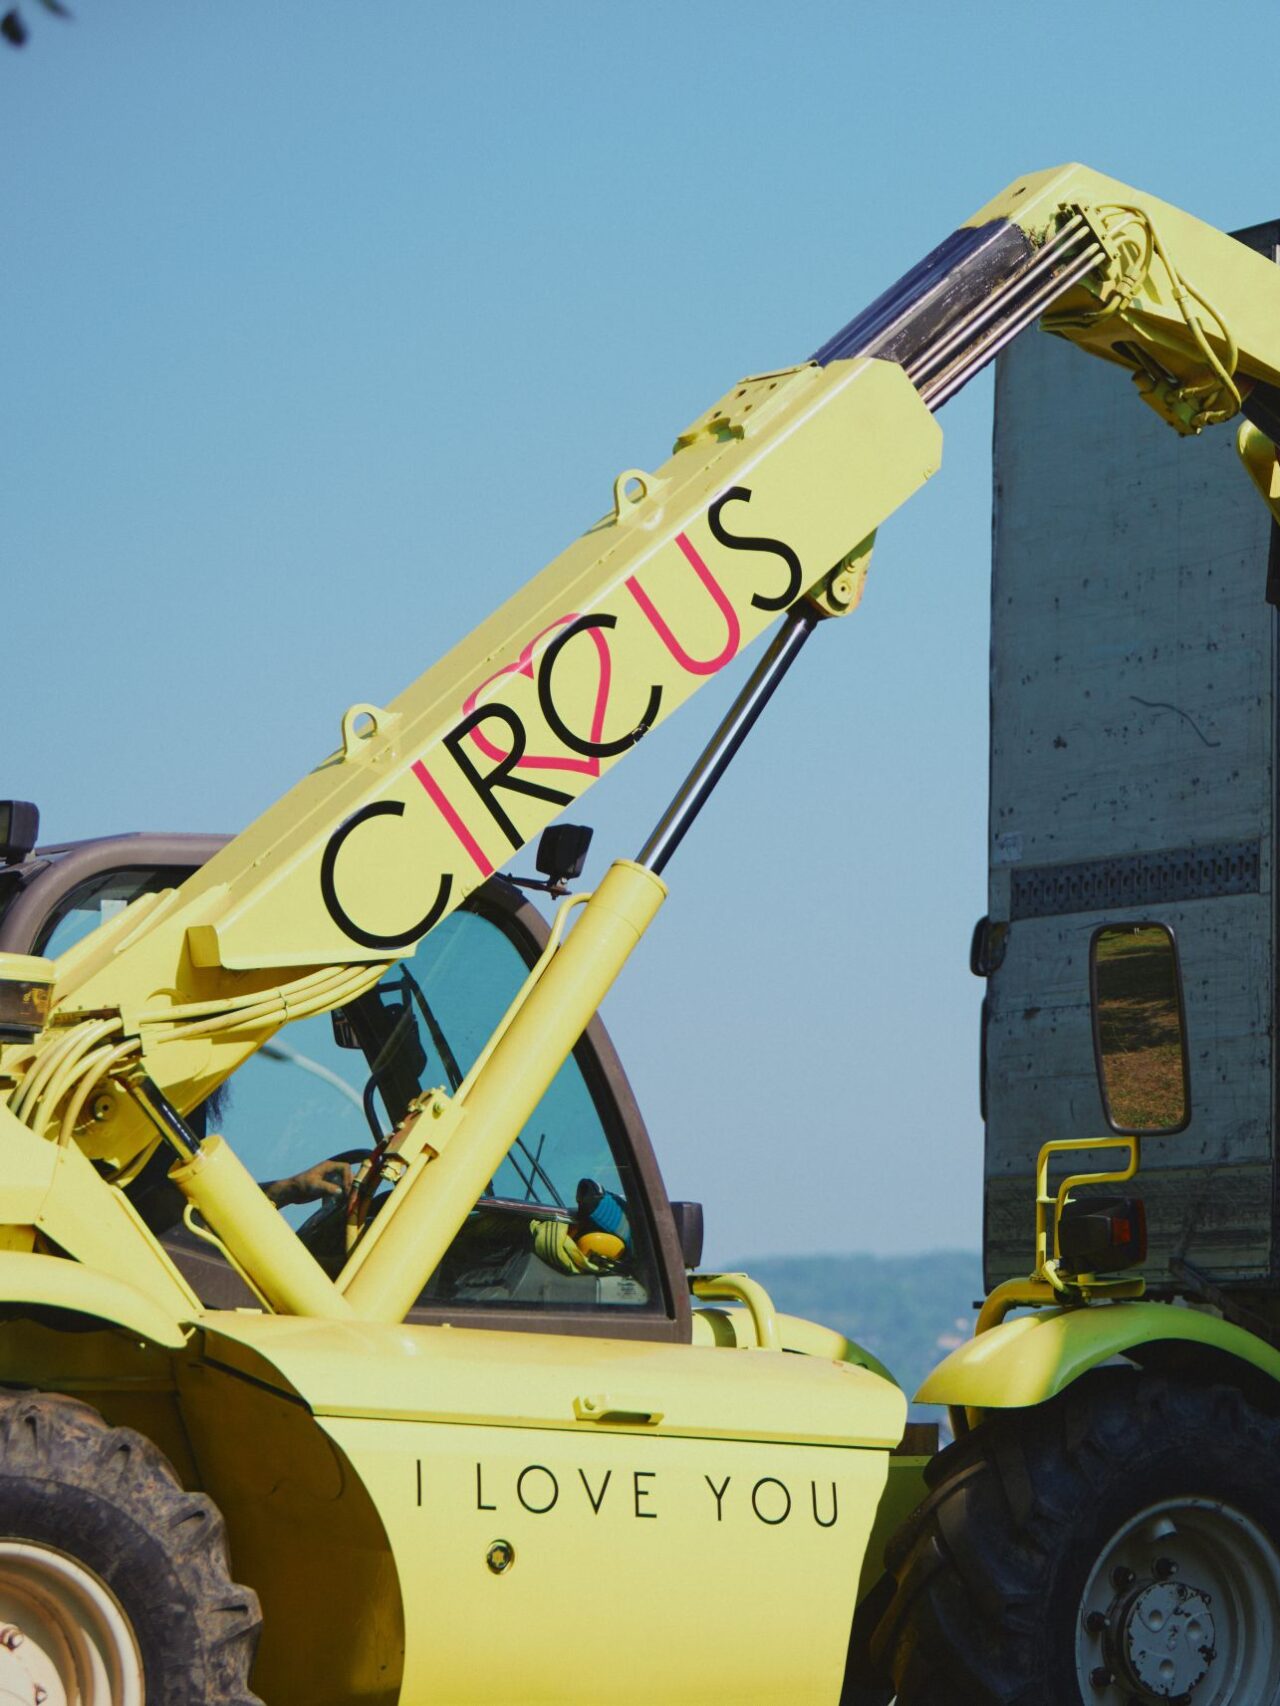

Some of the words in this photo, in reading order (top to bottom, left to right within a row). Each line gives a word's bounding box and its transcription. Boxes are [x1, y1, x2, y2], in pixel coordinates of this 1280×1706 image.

[320, 486, 803, 951] CIRCUS
[416, 1458, 422, 1507] I
[477, 1462, 658, 1519] LOVE
[704, 1474, 839, 1528] YOU
